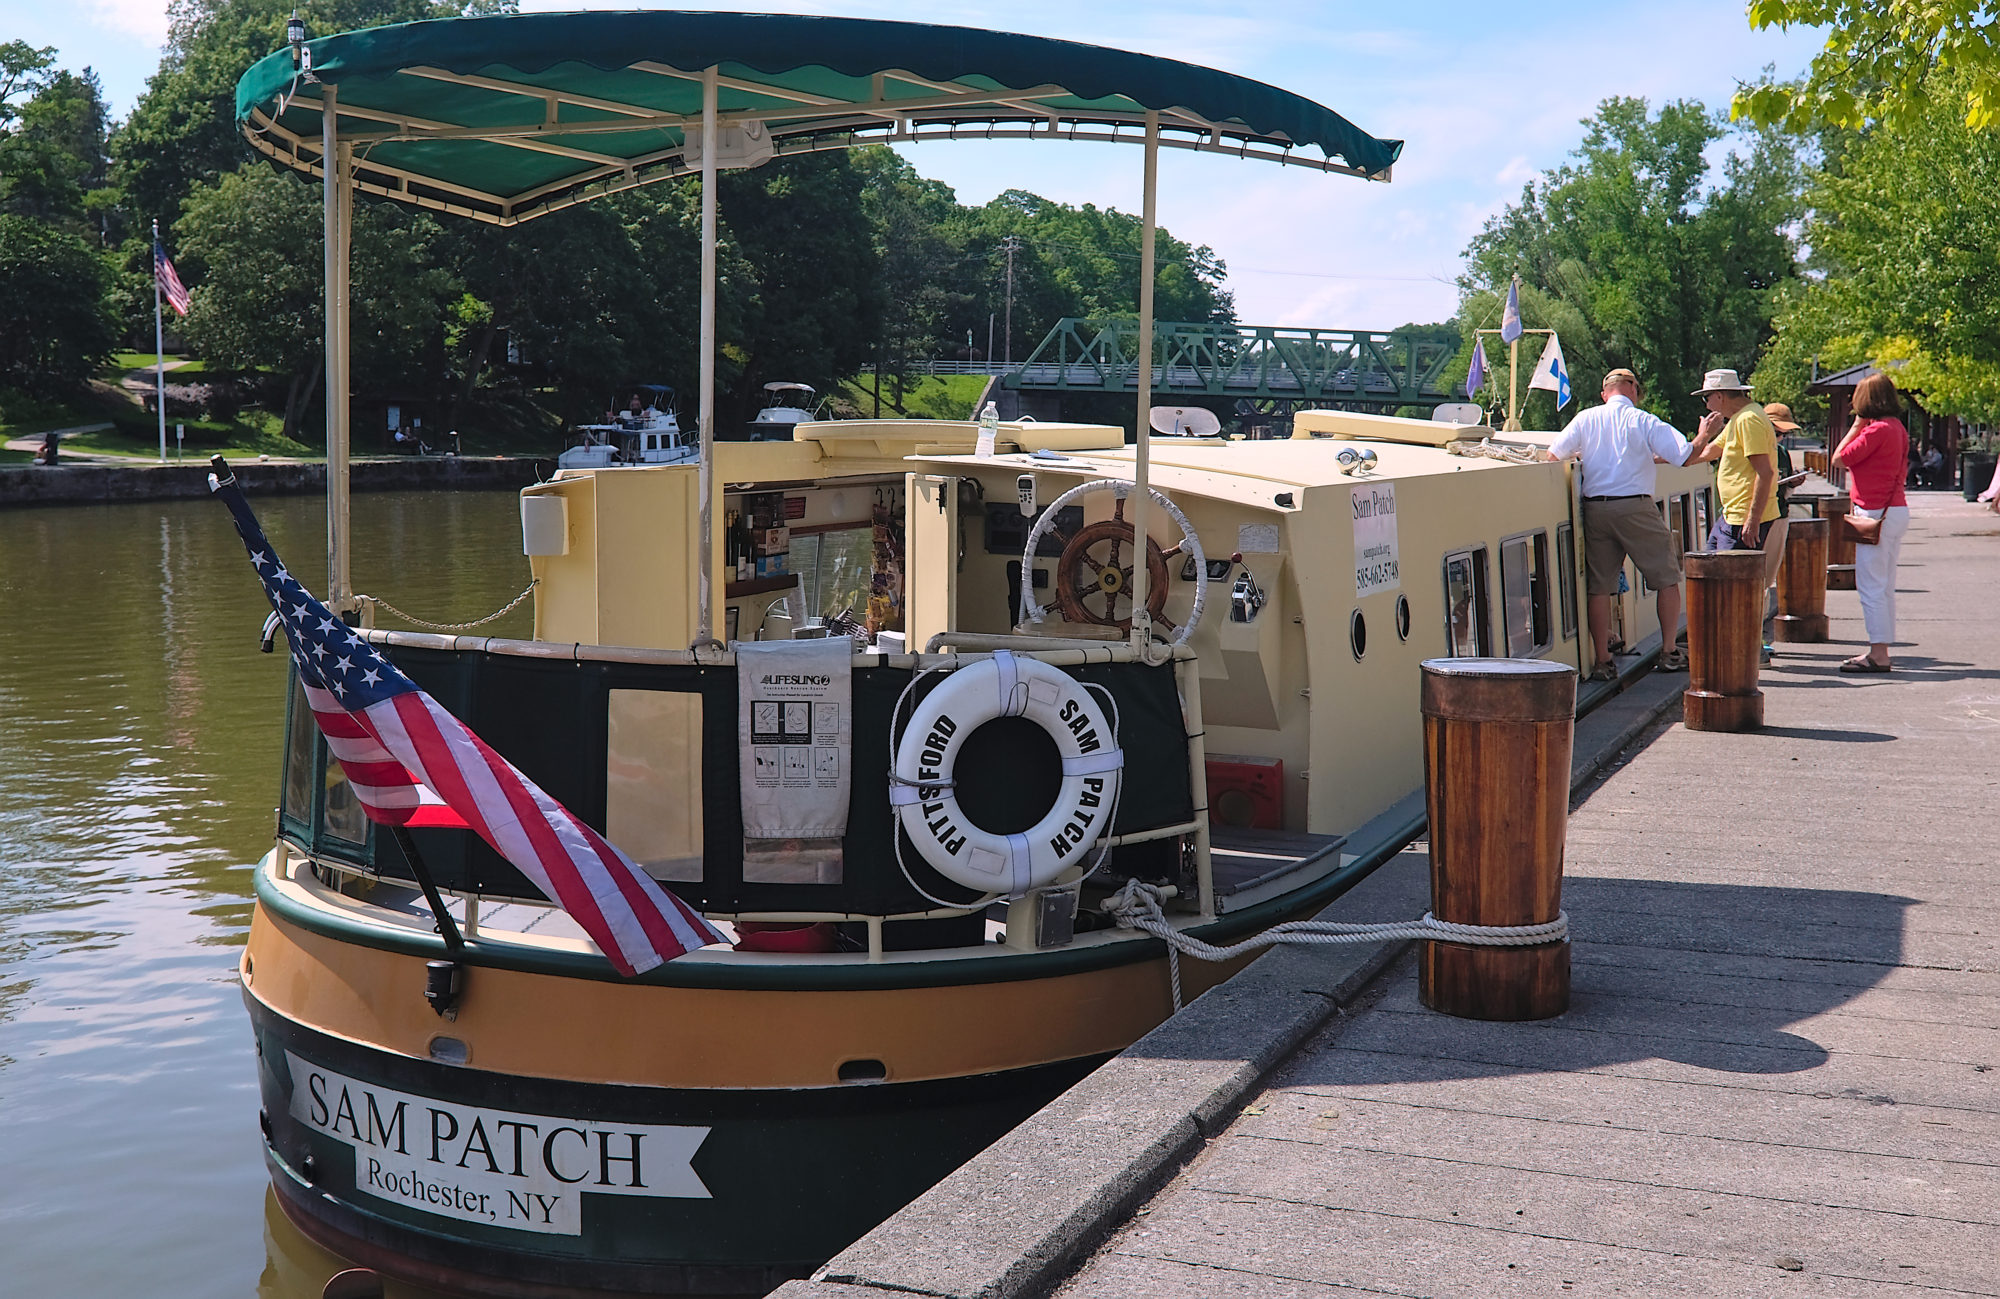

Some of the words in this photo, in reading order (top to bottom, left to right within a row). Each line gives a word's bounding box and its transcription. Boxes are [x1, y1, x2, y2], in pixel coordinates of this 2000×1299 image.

[1351, 492, 1372, 520] Sam
[1372, 488, 1395, 517] Patch
[1356, 560, 1399, 590] 585-662-5748
[1363, 543, 1391, 560] sampatch.org
[1059, 699, 1101, 755] SAM
[918, 714, 967, 857] PITTSFORD
[1050, 777, 1104, 859] PATCH
[309, 1072, 411, 1156] SAM
[426, 1107, 649, 1188] PATCH
[367, 1157, 497, 1222] Rochester,
[507, 1190, 561, 1224] NY
